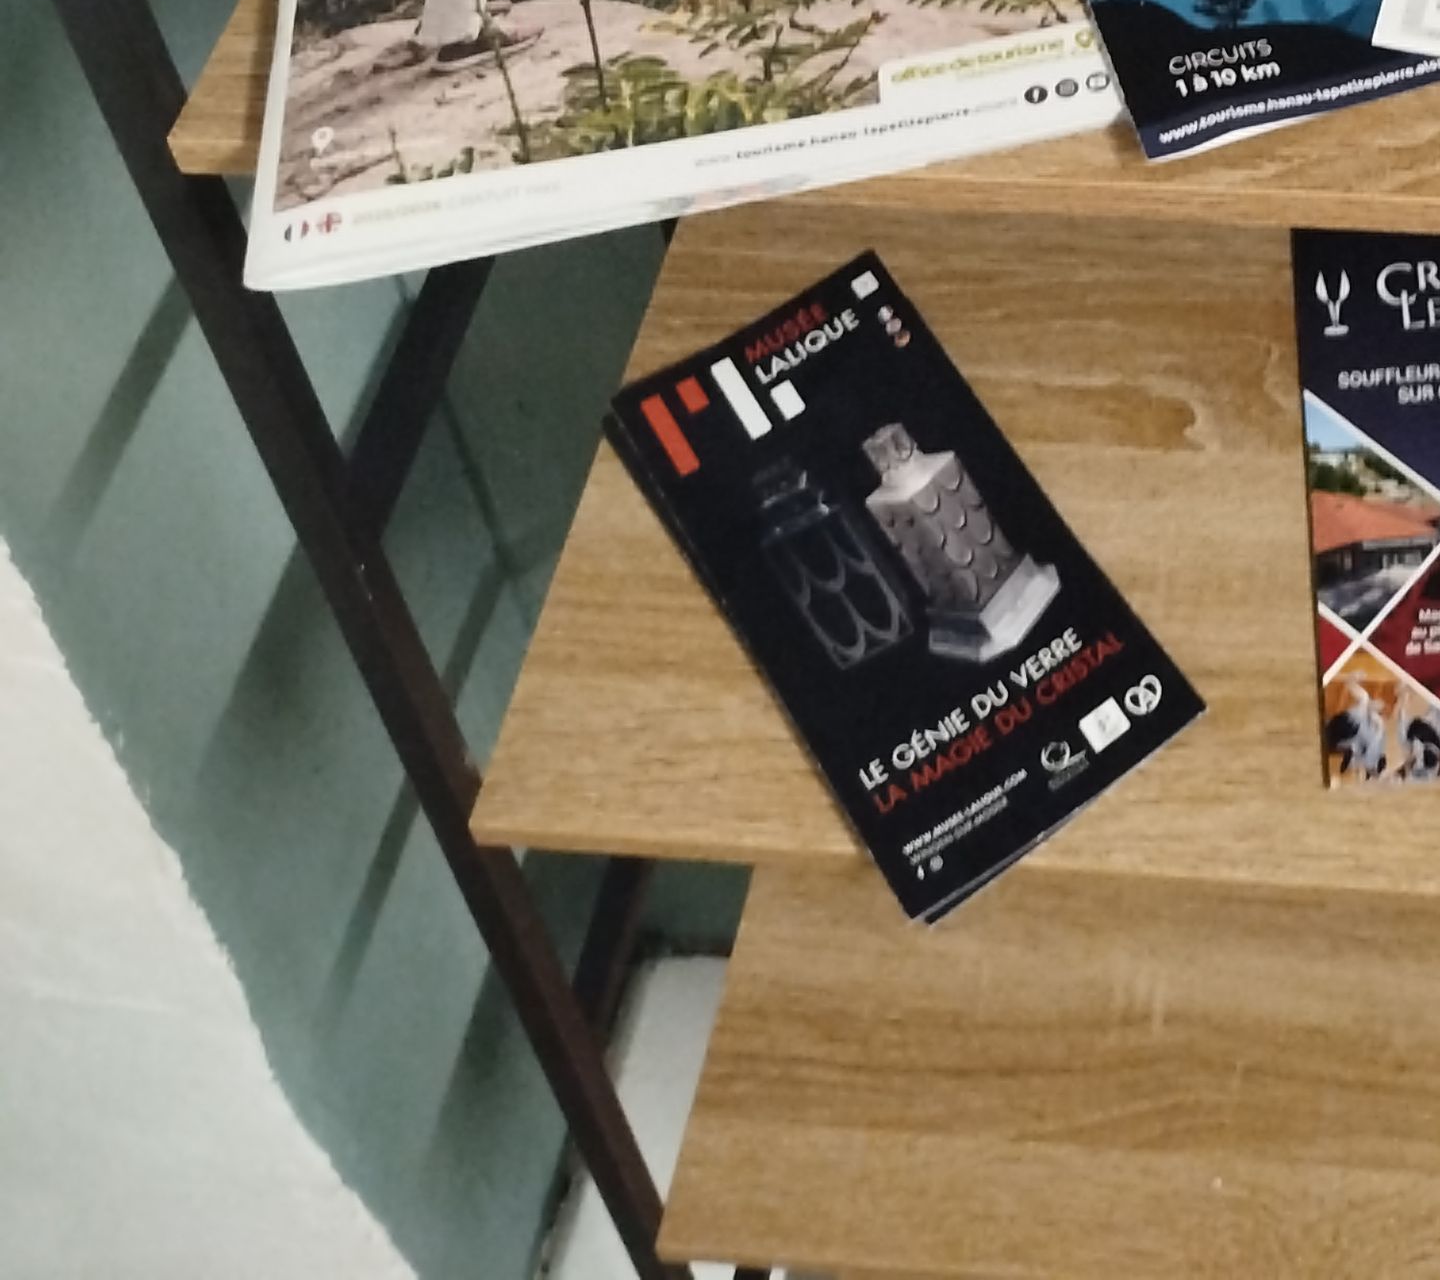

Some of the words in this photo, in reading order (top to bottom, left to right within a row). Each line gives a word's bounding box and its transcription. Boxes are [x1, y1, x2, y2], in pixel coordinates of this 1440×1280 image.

[1168, 38, 1274, 76] CIRCUITS
[1174, 77, 1189, 98] 1
[1209, 66, 1238, 89] 10
[1240, 58, 1282, 85] km
[754, 307, 860, 385] LALIQUE
[1398, 383, 1435, 406] SUR
[858, 757, 891, 792] LE
[892, 706, 972, 771] GÉNIE
[970, 679, 1011, 721] DU
[1009, 626, 1084, 690] VERRE
[873, 783, 908, 816] LA
[909, 725, 994, 792] MAGIE
[994, 696, 1034, 737] DU
[1035, 630, 1126, 706] CRISTAL
